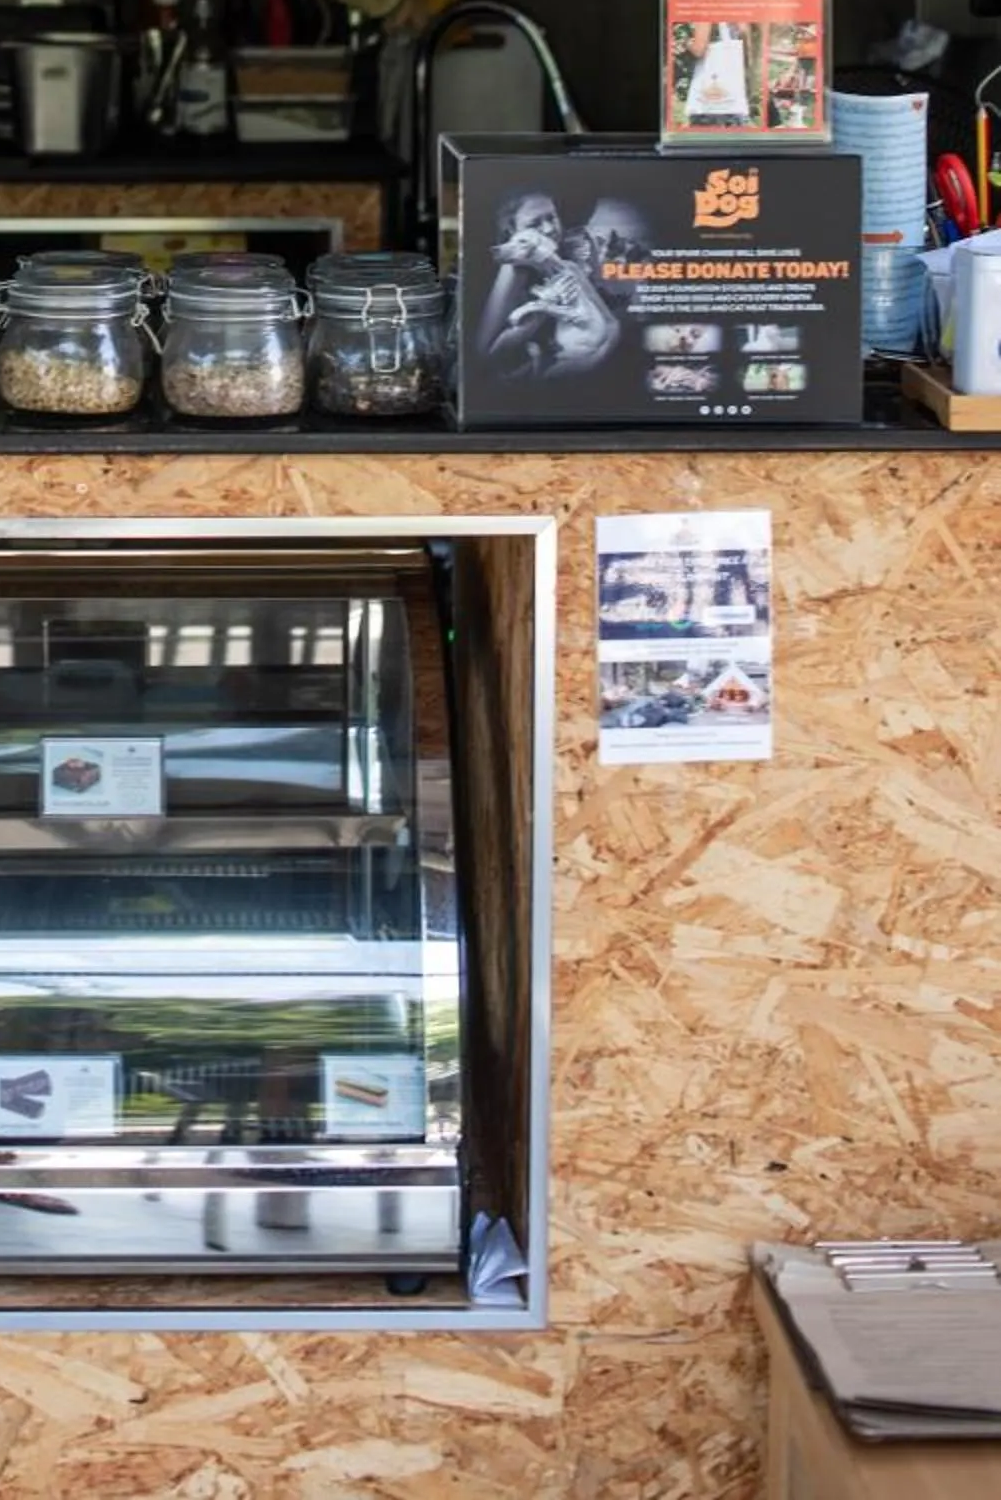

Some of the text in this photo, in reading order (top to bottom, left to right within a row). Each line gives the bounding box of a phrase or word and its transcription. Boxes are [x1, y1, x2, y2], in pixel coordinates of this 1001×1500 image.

[705, 167, 759, 195] Soi
[693, 190, 759, 228] Dog
[602, 260, 849, 280] PLEASE DONATE TODAY!
